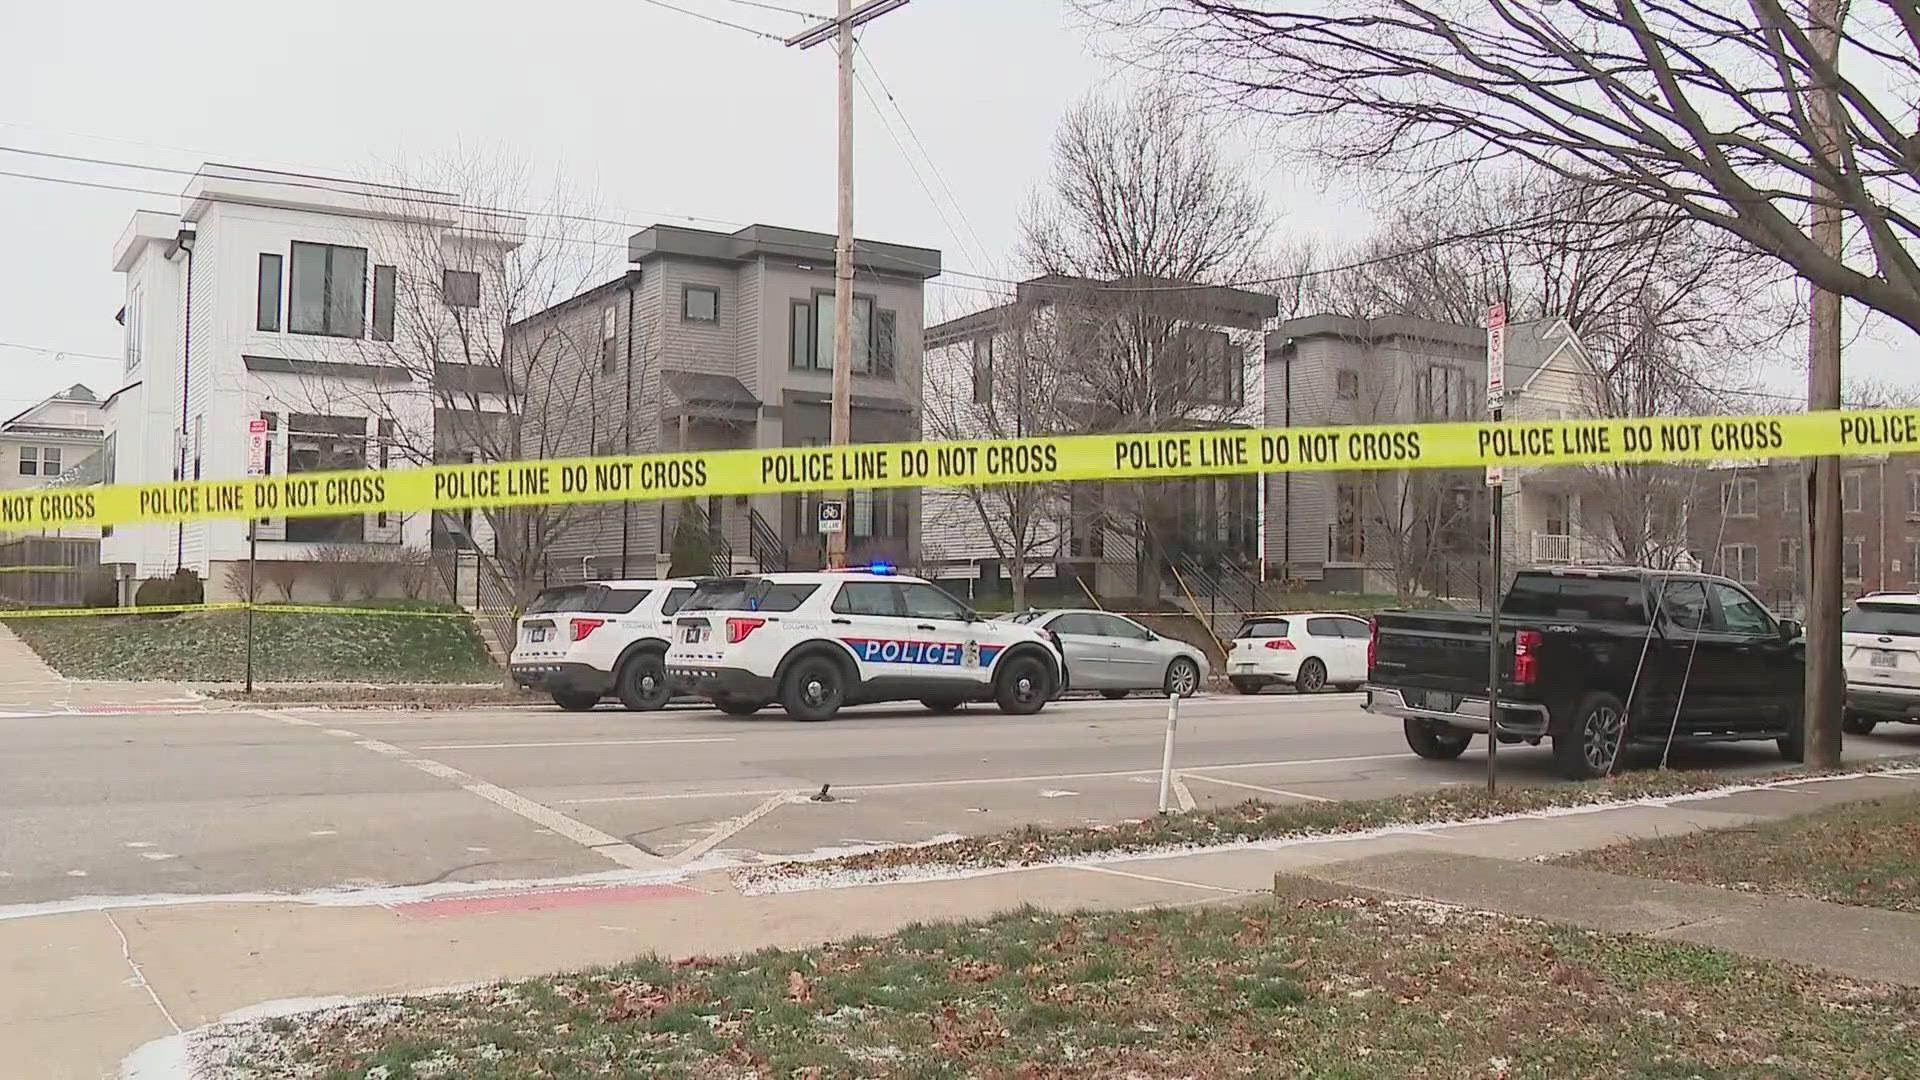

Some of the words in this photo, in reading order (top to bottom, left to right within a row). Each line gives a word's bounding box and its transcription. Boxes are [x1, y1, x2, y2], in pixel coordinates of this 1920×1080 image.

[1478, 428, 1555, 458] POLICE
[1562, 426, 1611, 454] LINE
[1623, 425, 1653, 452] DO
[1661, 424, 1702, 452] NOT
[1711, 421, 1783, 451] CROSS
[1840, 415, 1918, 445] POLICE
[762, 453, 834, 484] POLICE
[842, 451, 888, 481] LINE
[901, 448, 929, 478] DO
[937, 447, 978, 477] NOT
[986, 444, 1057, 475] CROSS
[1115, 439, 1192, 470] POLICE
[1199, 437, 1248, 467] LINE
[1261, 435, 1290, 465] DO
[1298, 433, 1340, 463] NOT
[1348, 431, 1421, 462] CROSS
[140, 489, 199, 515] POLICE
[206, 485, 243, 512] LINE
[255, 483, 278, 509] DO
[284, 481, 319, 508] NOT
[325, 477, 385, 506] CROSS
[435, 470, 500, 500] POLICE
[507, 467, 550, 496] LINE
[562, 465, 588, 493] DO
[595, 463, 634, 492] NOT
[641, 459, 707, 490] CROSS
[2, 497, 34, 522] NOT
[40, 494, 95, 521] CROSS
[864, 640, 957, 664] POLICE
